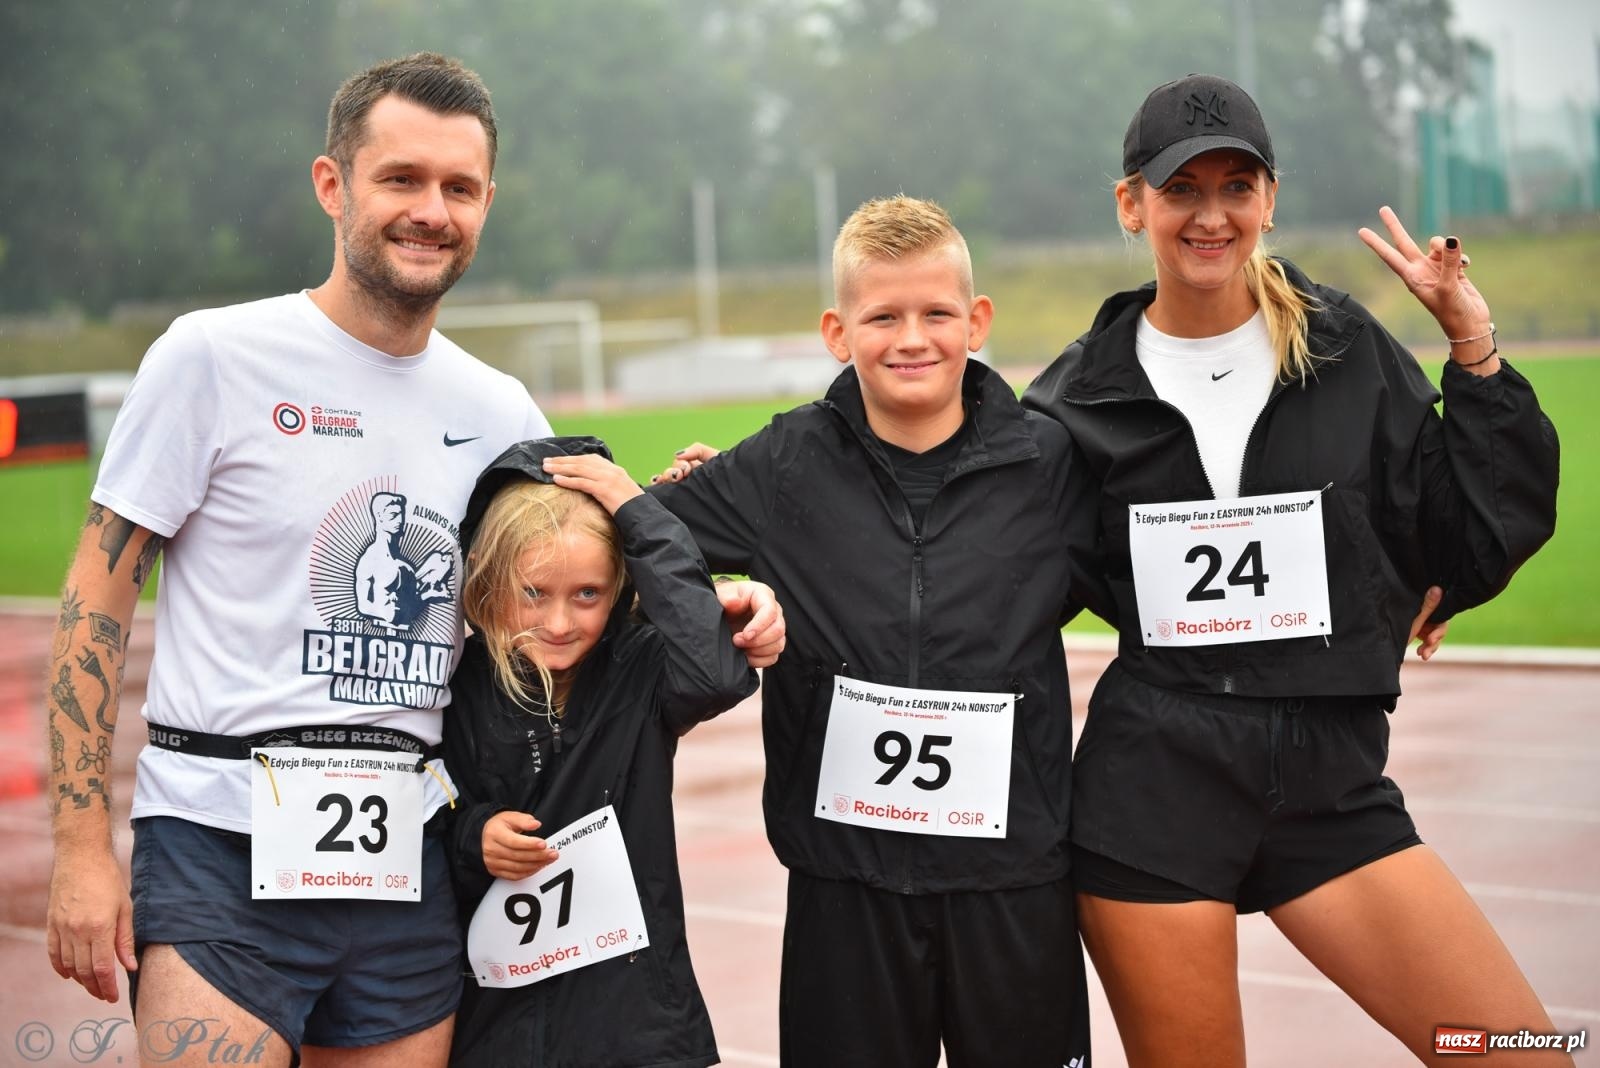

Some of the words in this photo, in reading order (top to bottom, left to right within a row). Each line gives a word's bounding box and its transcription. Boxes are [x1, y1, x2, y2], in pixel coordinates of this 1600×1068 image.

[312, 415, 358, 428] BELGRADE
[324, 408, 362, 417] COMTRADE
[313, 425, 363, 439] MARATHON
[412, 505, 449, 529] ALWAYS
[1142, 514, 1167, 525] Edycja
[1169, 512, 1191, 524] Biegu
[1193, 511, 1208, 521] Fun
[1210, 512, 1215, 520] z
[1217, 507, 1254, 519] EASYRUN
[1256, 505, 1272, 516] 24h
[1273, 502, 1310, 514] NONSTOP
[1184, 540, 1269, 602] 24
[333, 619, 364, 635] 38TH
[1176, 617, 1252, 635] Racibórz
[1270, 612, 1308, 628] OSiR
[334, 676, 440, 709] MARATHON
[844, 687, 865, 702] Edycja
[865, 692, 887, 706] Biegu
[888, 696, 904, 707] Fun
[905, 700, 911, 708] z
[911, 699, 950, 711] EASYRUN
[951, 701, 967, 711] 24h
[969, 702, 1004, 713] NONSTOP
[527, 729, 542, 774] KIPSTA
[873, 730, 953, 791] 95
[270, 757, 300, 770] Edycja
[301, 757, 326, 769] Biegu
[327, 757, 343, 768] Fun
[344, 760, 349, 768] z
[350, 759, 383, 770] EASYRUN
[383, 761, 396, 771] 24h
[396, 762, 416, 774] NONSTO
[315, 793, 388, 854] 23
[853, 800, 929, 823] Racibórz
[947, 811, 985, 826] OSiR
[556, 837, 571, 850] 24h
[572, 819, 608, 842] NONSTOP
[301, 871, 373, 887] Racibórz
[385, 874, 409, 889] OSiR
[504, 867, 574, 946] 97
[508, 944, 581, 977] Racibórz
[596, 928, 629, 949] OSiR
